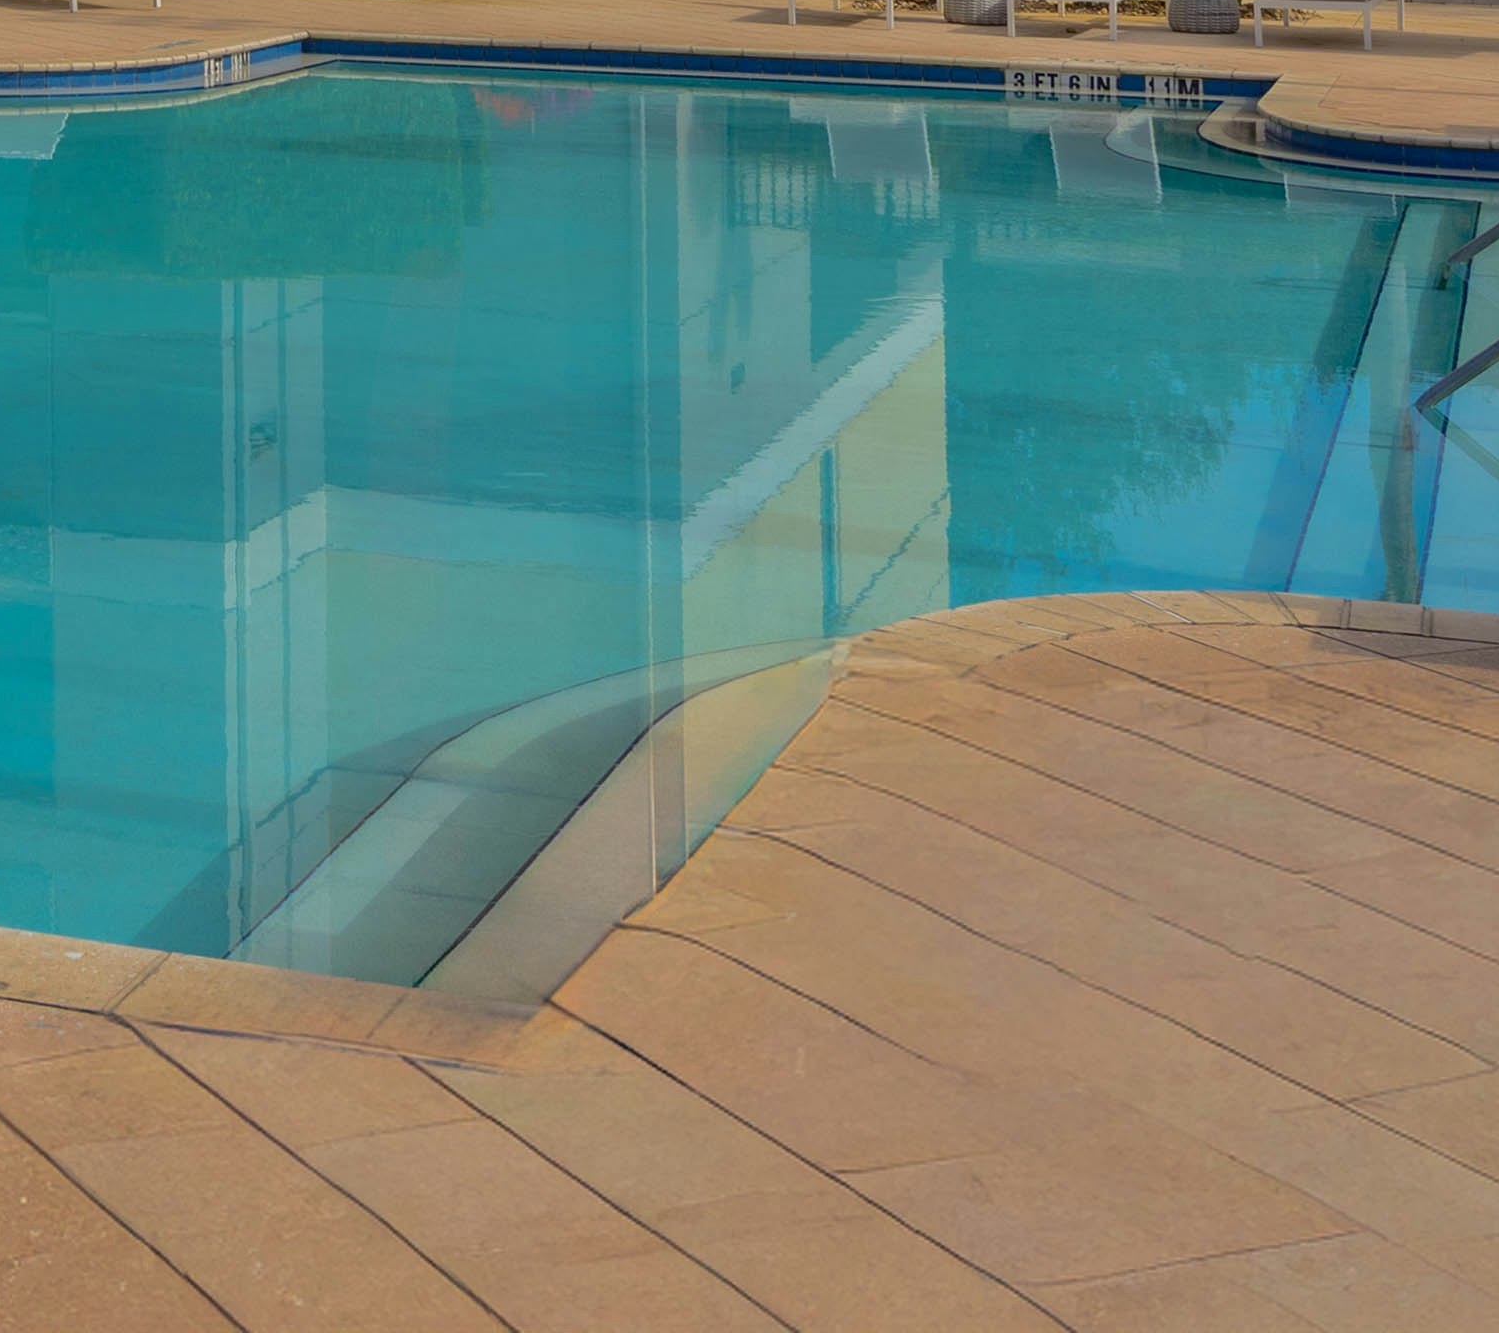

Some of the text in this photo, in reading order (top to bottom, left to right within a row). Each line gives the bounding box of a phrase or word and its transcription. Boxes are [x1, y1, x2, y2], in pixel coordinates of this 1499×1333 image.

[1014, 73, 1111, 91] 3 FT 6 IN
[1178, 78, 1200, 94] M
